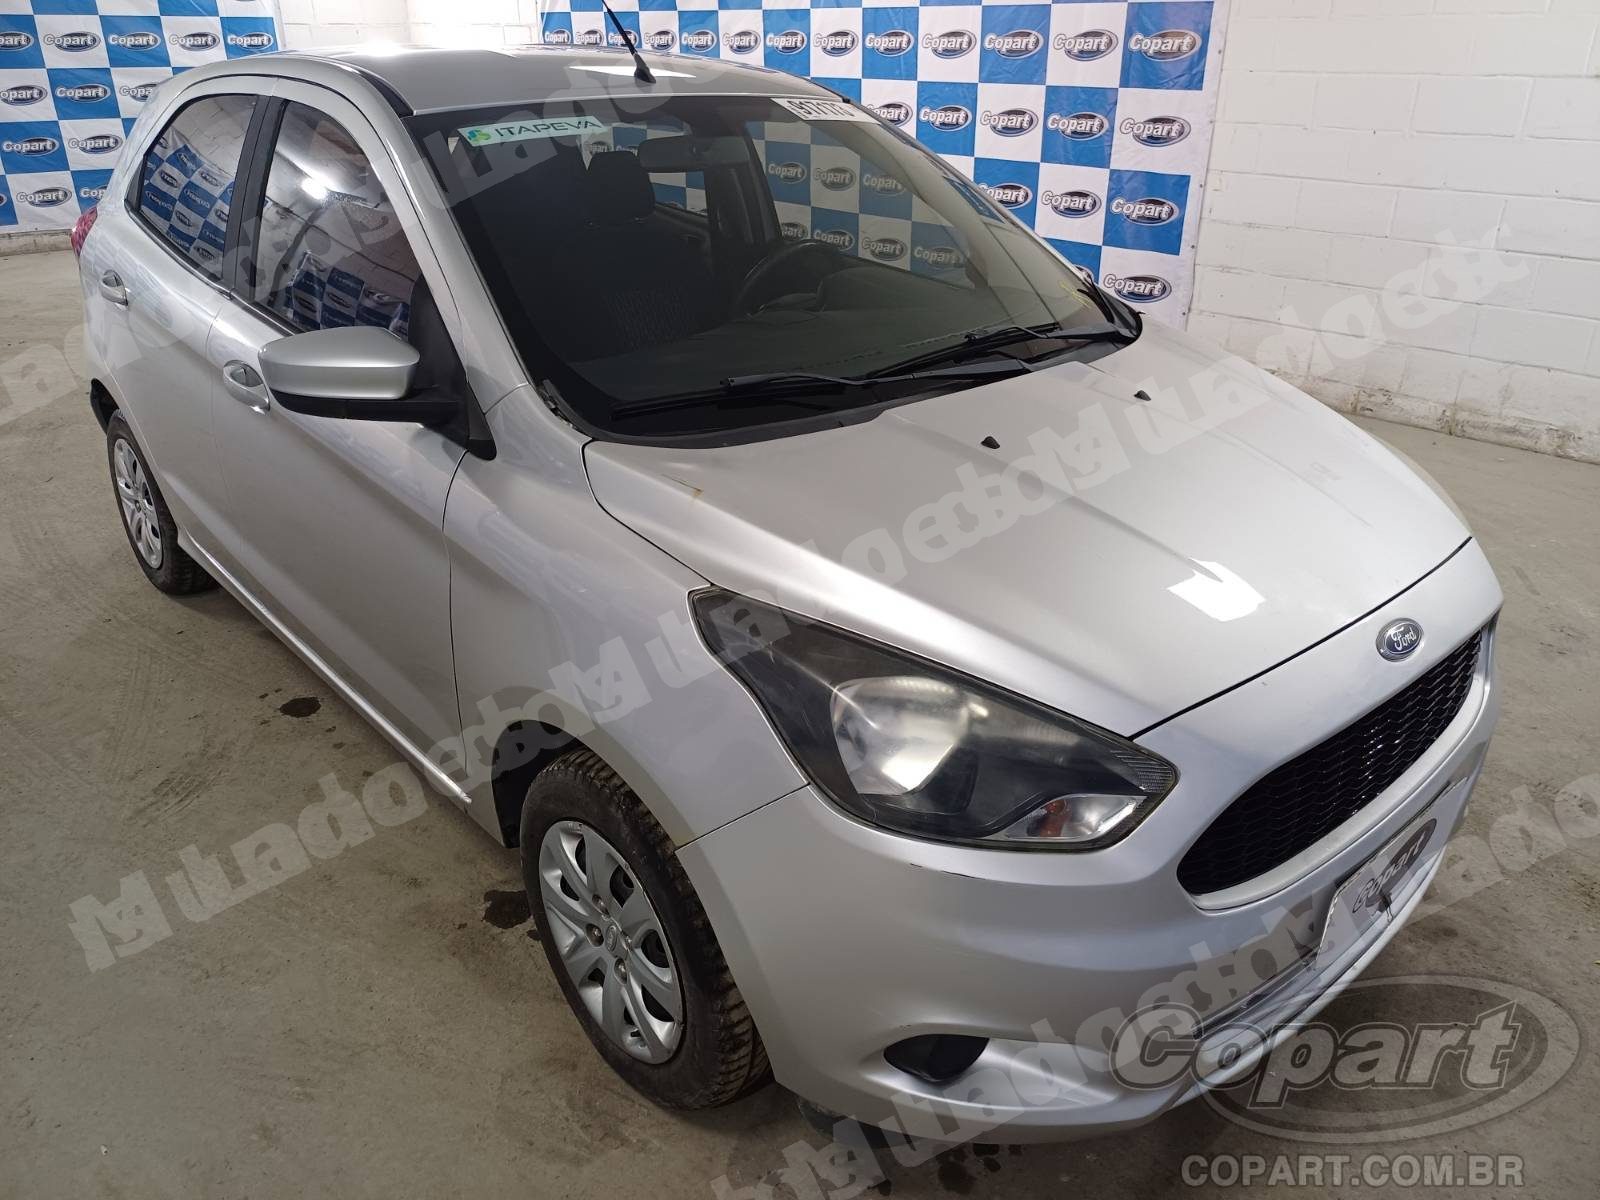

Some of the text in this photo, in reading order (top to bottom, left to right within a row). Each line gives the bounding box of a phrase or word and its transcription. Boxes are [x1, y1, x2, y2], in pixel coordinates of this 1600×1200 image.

[44, 34, 93, 50] Copart
[109, 34, 155, 48] Copart
[169, 34, 214, 48] Copart
[227, 34, 269, 48] Copart
[544, 32, 568, 44] Copart
[575, 32, 601, 45] Copart
[644, 32, 674, 47] Copart
[681, 32, 713, 47] Copart
[722, 31, 757, 49] Copart
[766, 31, 802, 49] Copart
[813, 30, 852, 50] Copart
[865, 31, 908, 51] Copart
[922, 31, 972, 53] Copart
[984, 30, 1039, 54] Copart
[1053, 30, 1114, 55] Copart
[1129, 30, 1192, 54] Copart
[56, 86, 104, 100] Copart
[919, 106, 967, 127] Copart
[980, 107, 1030, 130] Copart
[1047, 111, 1101, 134] Copart
[495, 119, 602, 137] ITAPEVA
[1120, 117, 1180, 141] Copart
[3, 138, 53, 153] Copart
[68, 137, 116, 151] Copart
[768, 161, 803, 179] Copart
[813, 167, 852, 184] Copart
[16, 190, 65, 204] Copart
[1041, 190, 1094, 212] Copart
[1111, 197, 1175, 221] Copart
[813, 230, 852, 247] Copart
[861, 238, 902, 256] Copart
[1103, 273, 1163, 298] Copart
[1390, 626, 1417, 651] Ford
[1352, 830, 1426, 914] Copart
